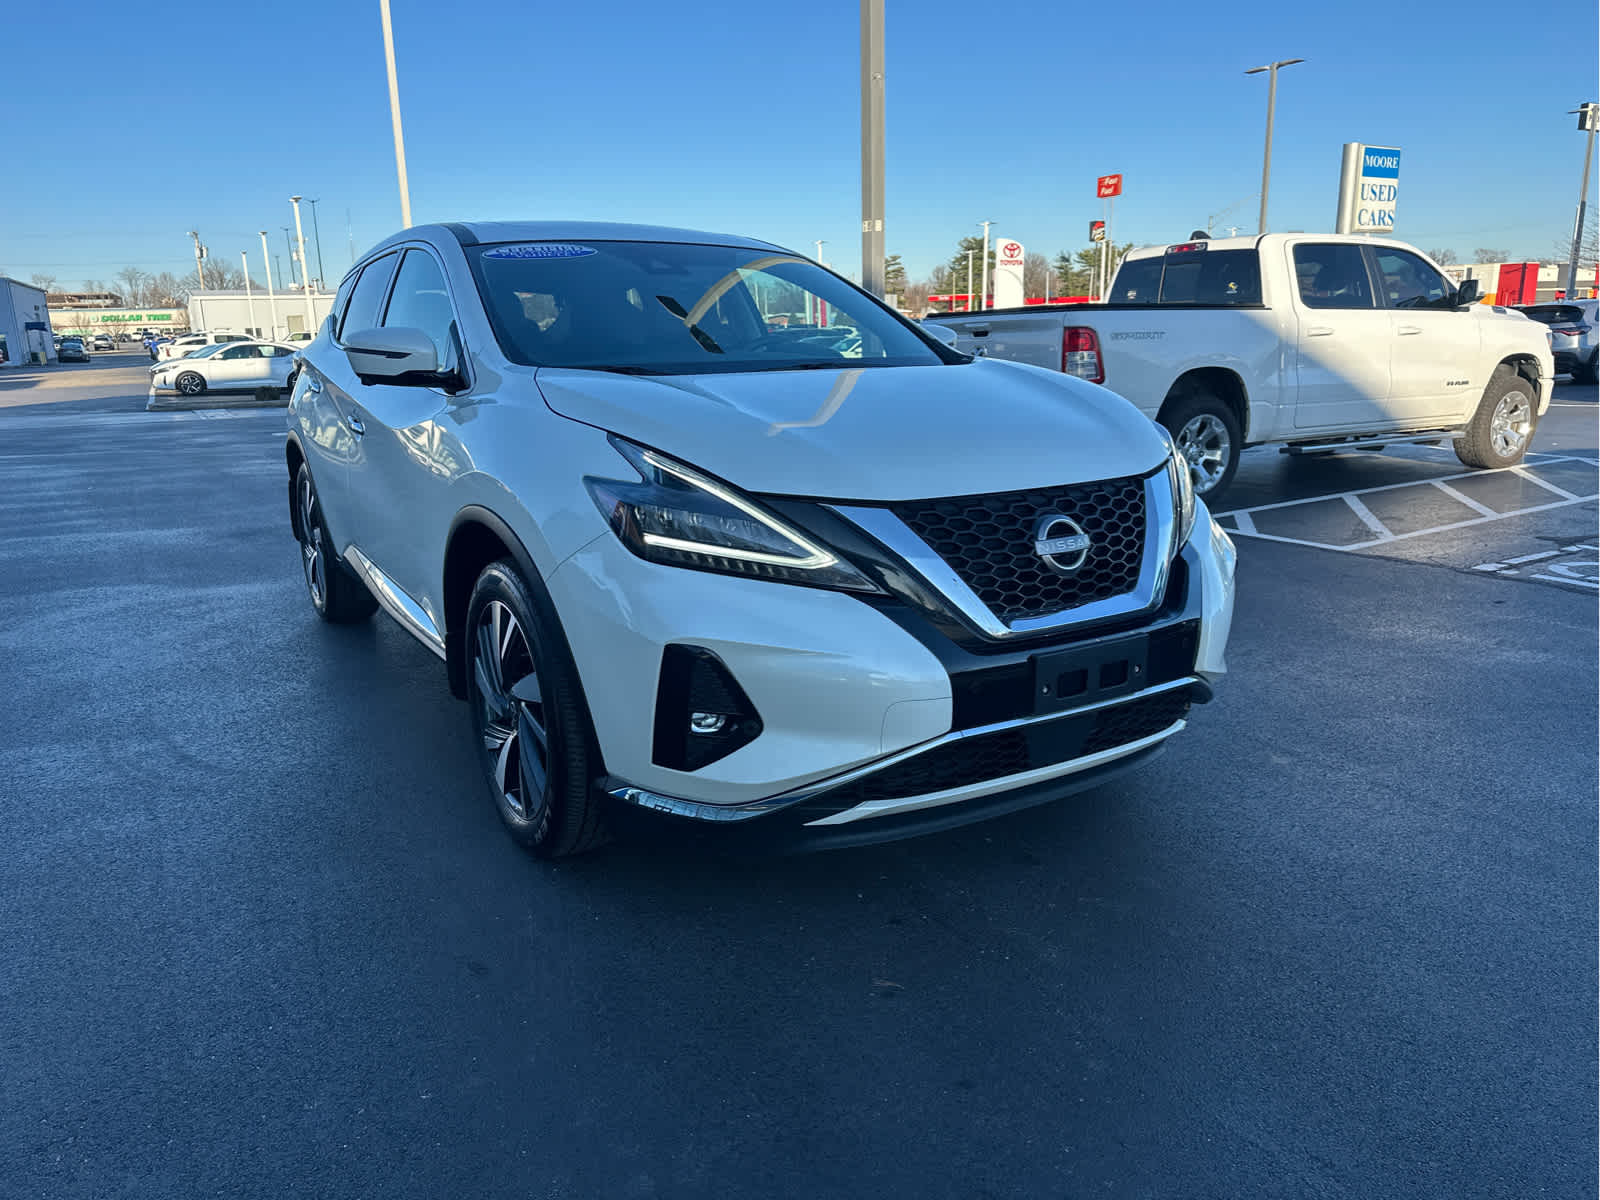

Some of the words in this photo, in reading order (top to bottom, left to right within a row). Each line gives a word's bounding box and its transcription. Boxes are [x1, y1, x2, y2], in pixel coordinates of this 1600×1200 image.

[1364, 155, 1399, 169] MOORE
[1360, 183, 1397, 202] USED
[1358, 209, 1394, 226] CARS
[101, 314, 142, 322] DOLLAR
